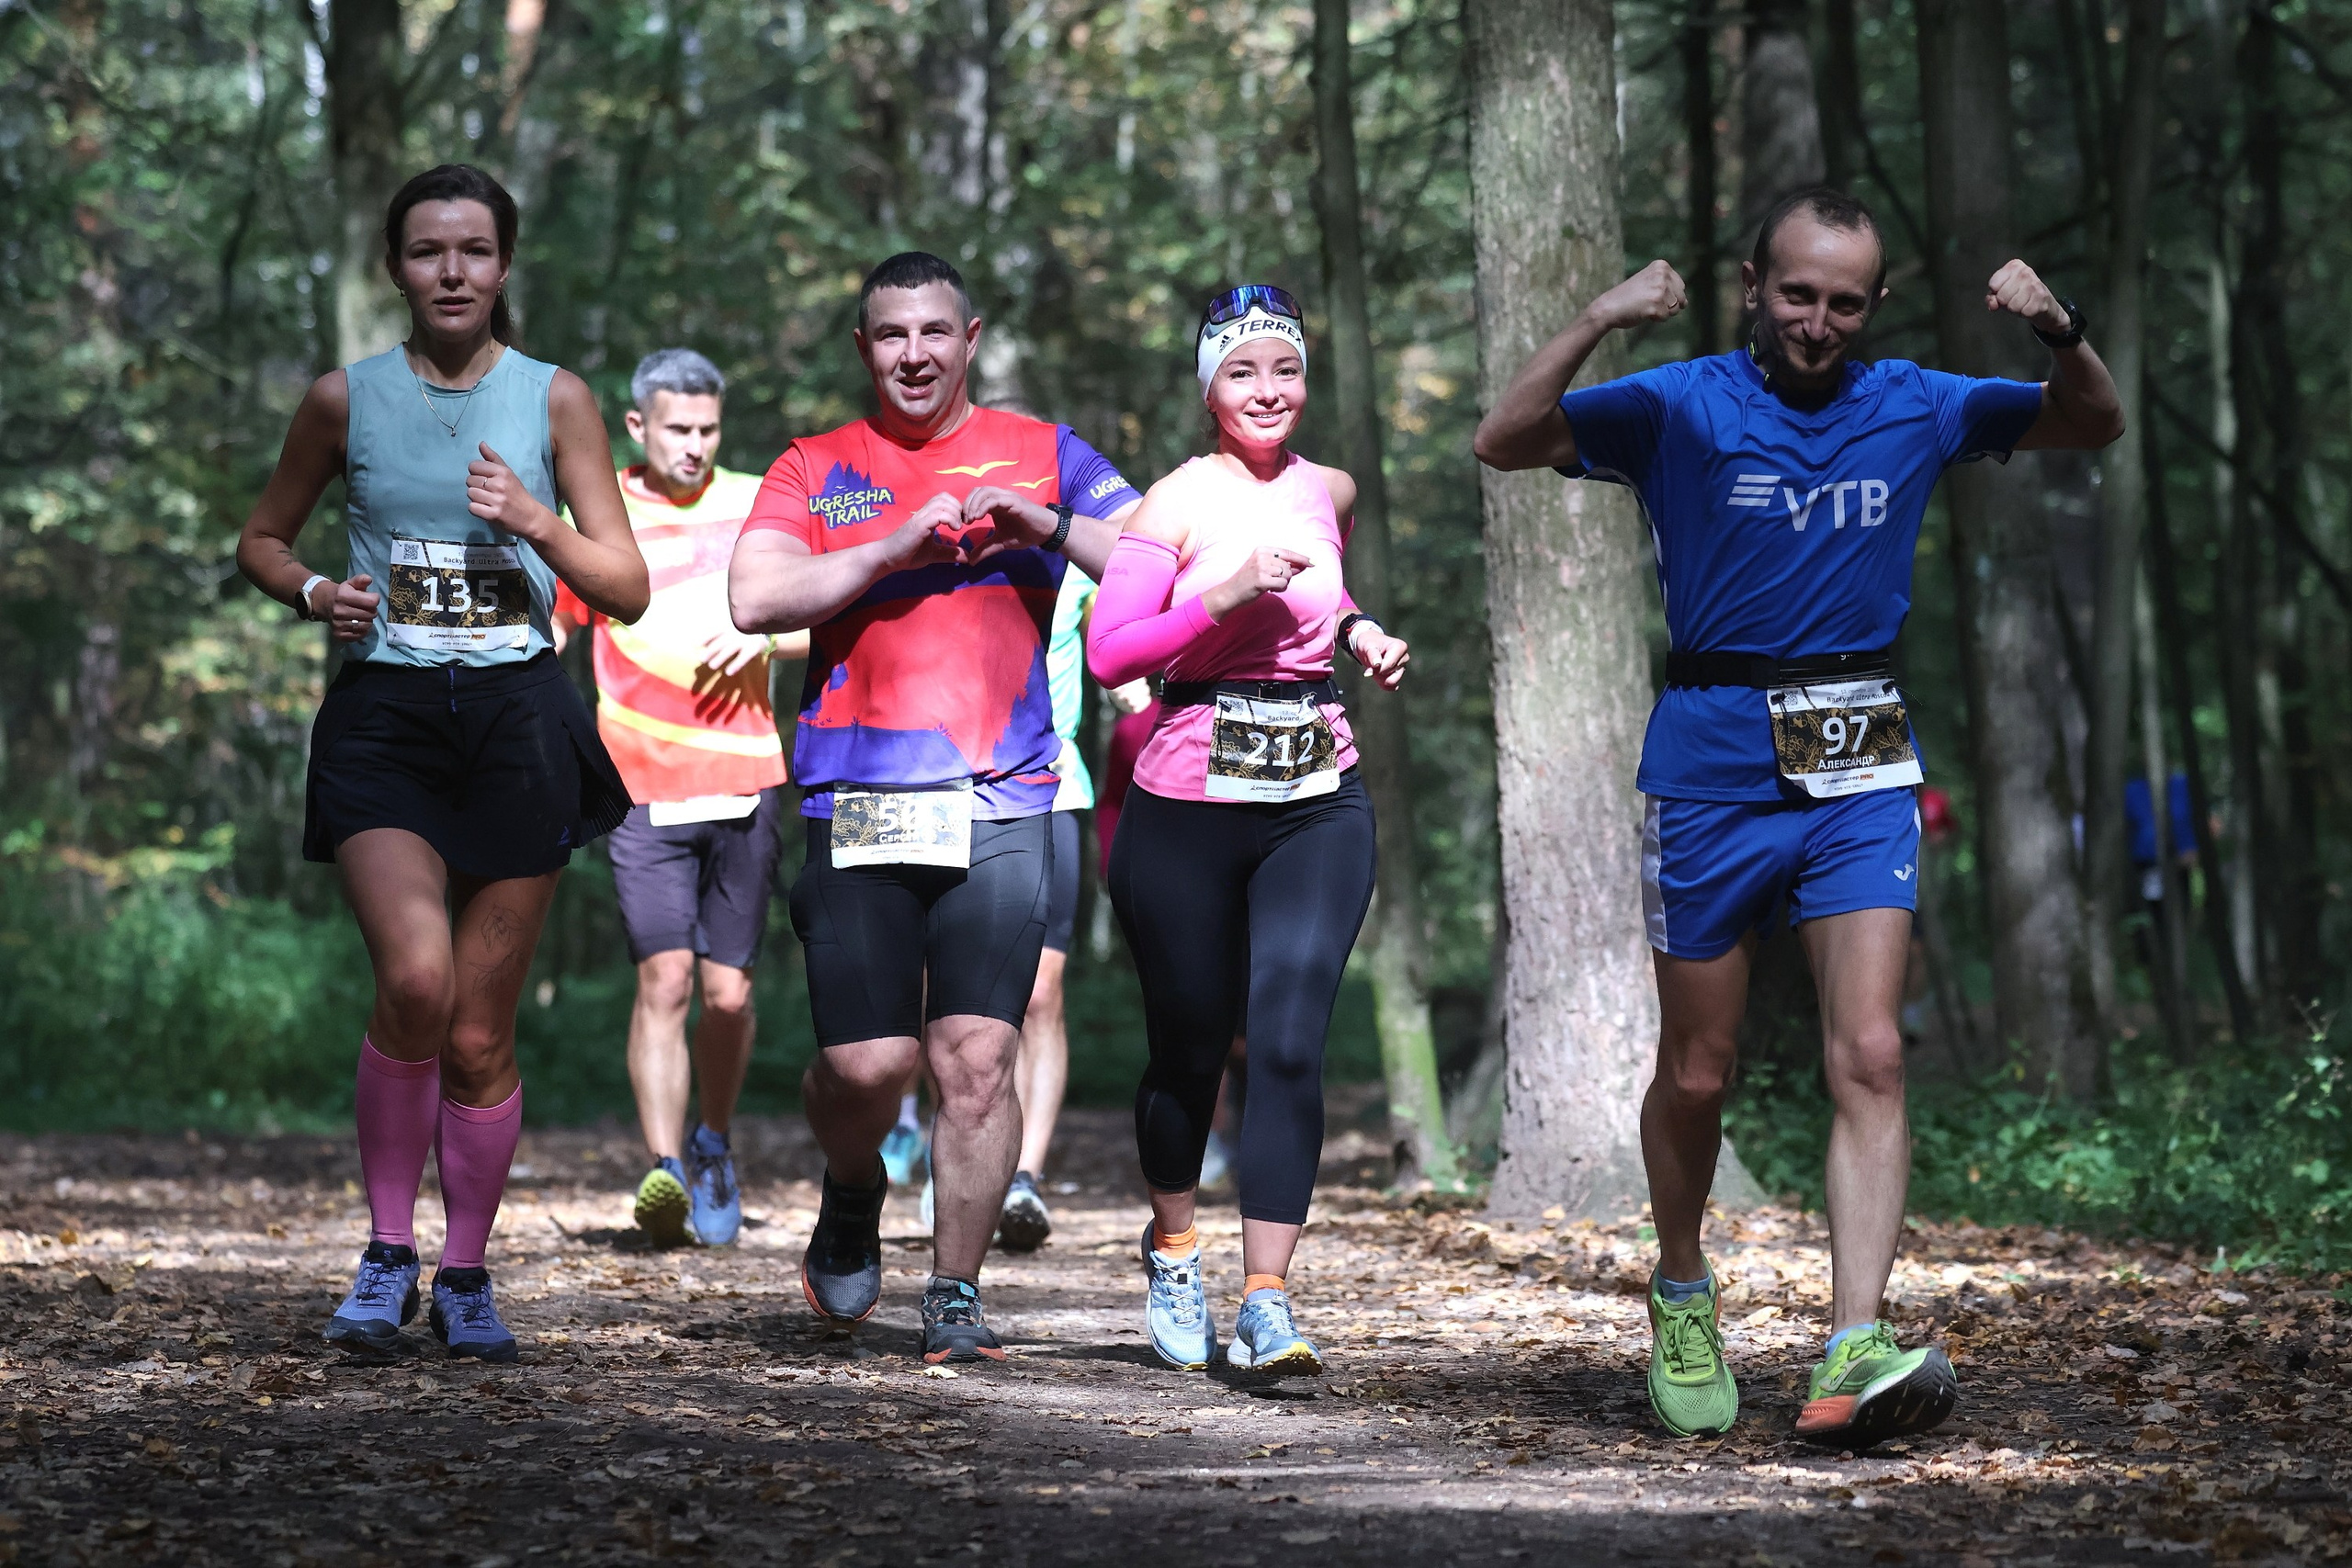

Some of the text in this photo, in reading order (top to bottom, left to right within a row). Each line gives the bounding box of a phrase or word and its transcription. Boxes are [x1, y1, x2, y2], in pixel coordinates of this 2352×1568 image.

[1238, 320, 1303, 347] TERREX
[809, 489, 892, 513] UGRESHA
[1090, 476, 1131, 499] UGRE
[825, 504, 880, 528] TRAIL
[1782, 479, 1890, 532] VTB
[443, 557, 475, 565] Backyard
[421, 577, 500, 614] 135
[1244, 731, 1315, 767] 212
[1822, 715, 1869, 756] 97
